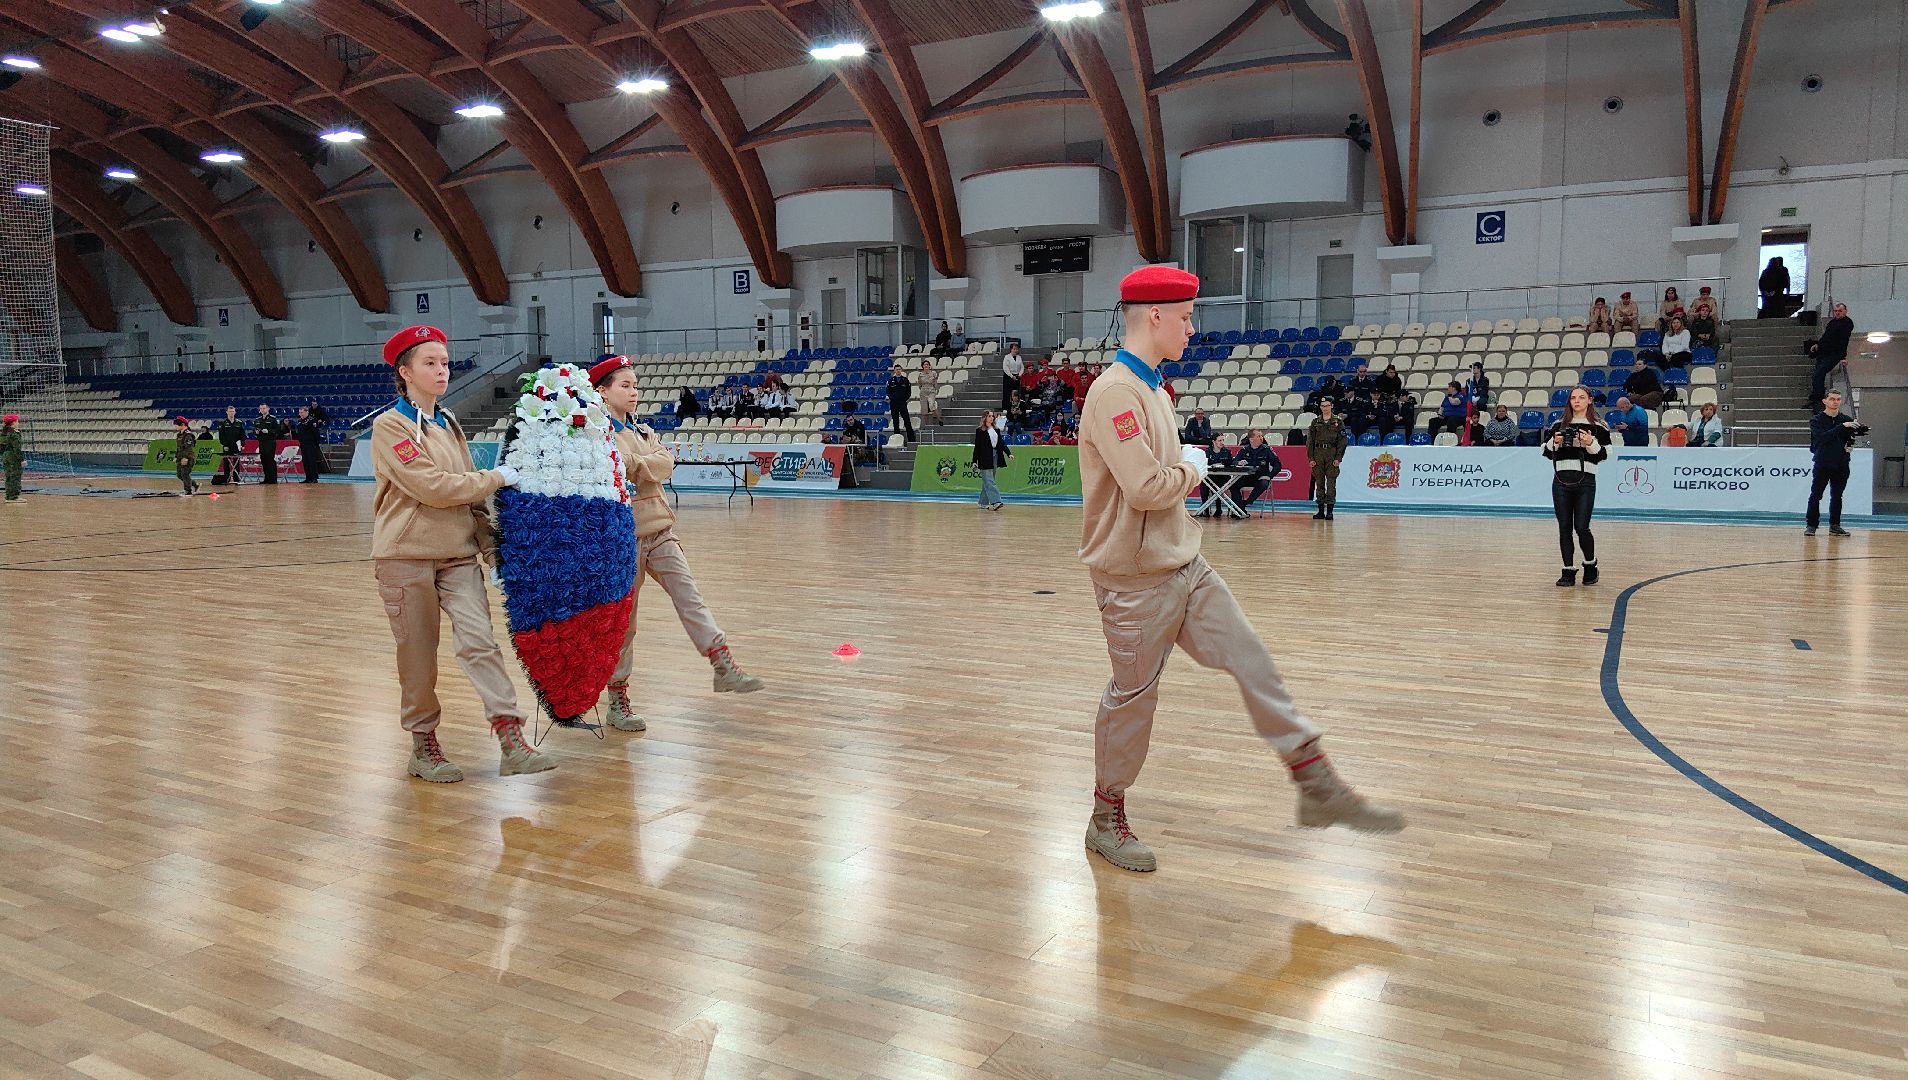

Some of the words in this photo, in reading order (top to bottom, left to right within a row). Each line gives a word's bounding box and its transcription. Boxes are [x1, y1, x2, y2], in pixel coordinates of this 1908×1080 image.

[754, 456, 835, 470] ФЕСТИВАЛЬ
[1030, 457, 1060, 468] СПОРТ
[1028, 467, 1065, 476] НОРМА
[1413, 463, 1484, 475] КОМАНДА
[1674, 465, 1765, 478] ГОРОДСКОЙ
[1027, 477, 1062, 486] ЖИЗНИ
[1411, 477, 1511, 488] ГУБЕРНАТОРА
[1673, 480, 1750, 491] ЩЕЛКОВО
